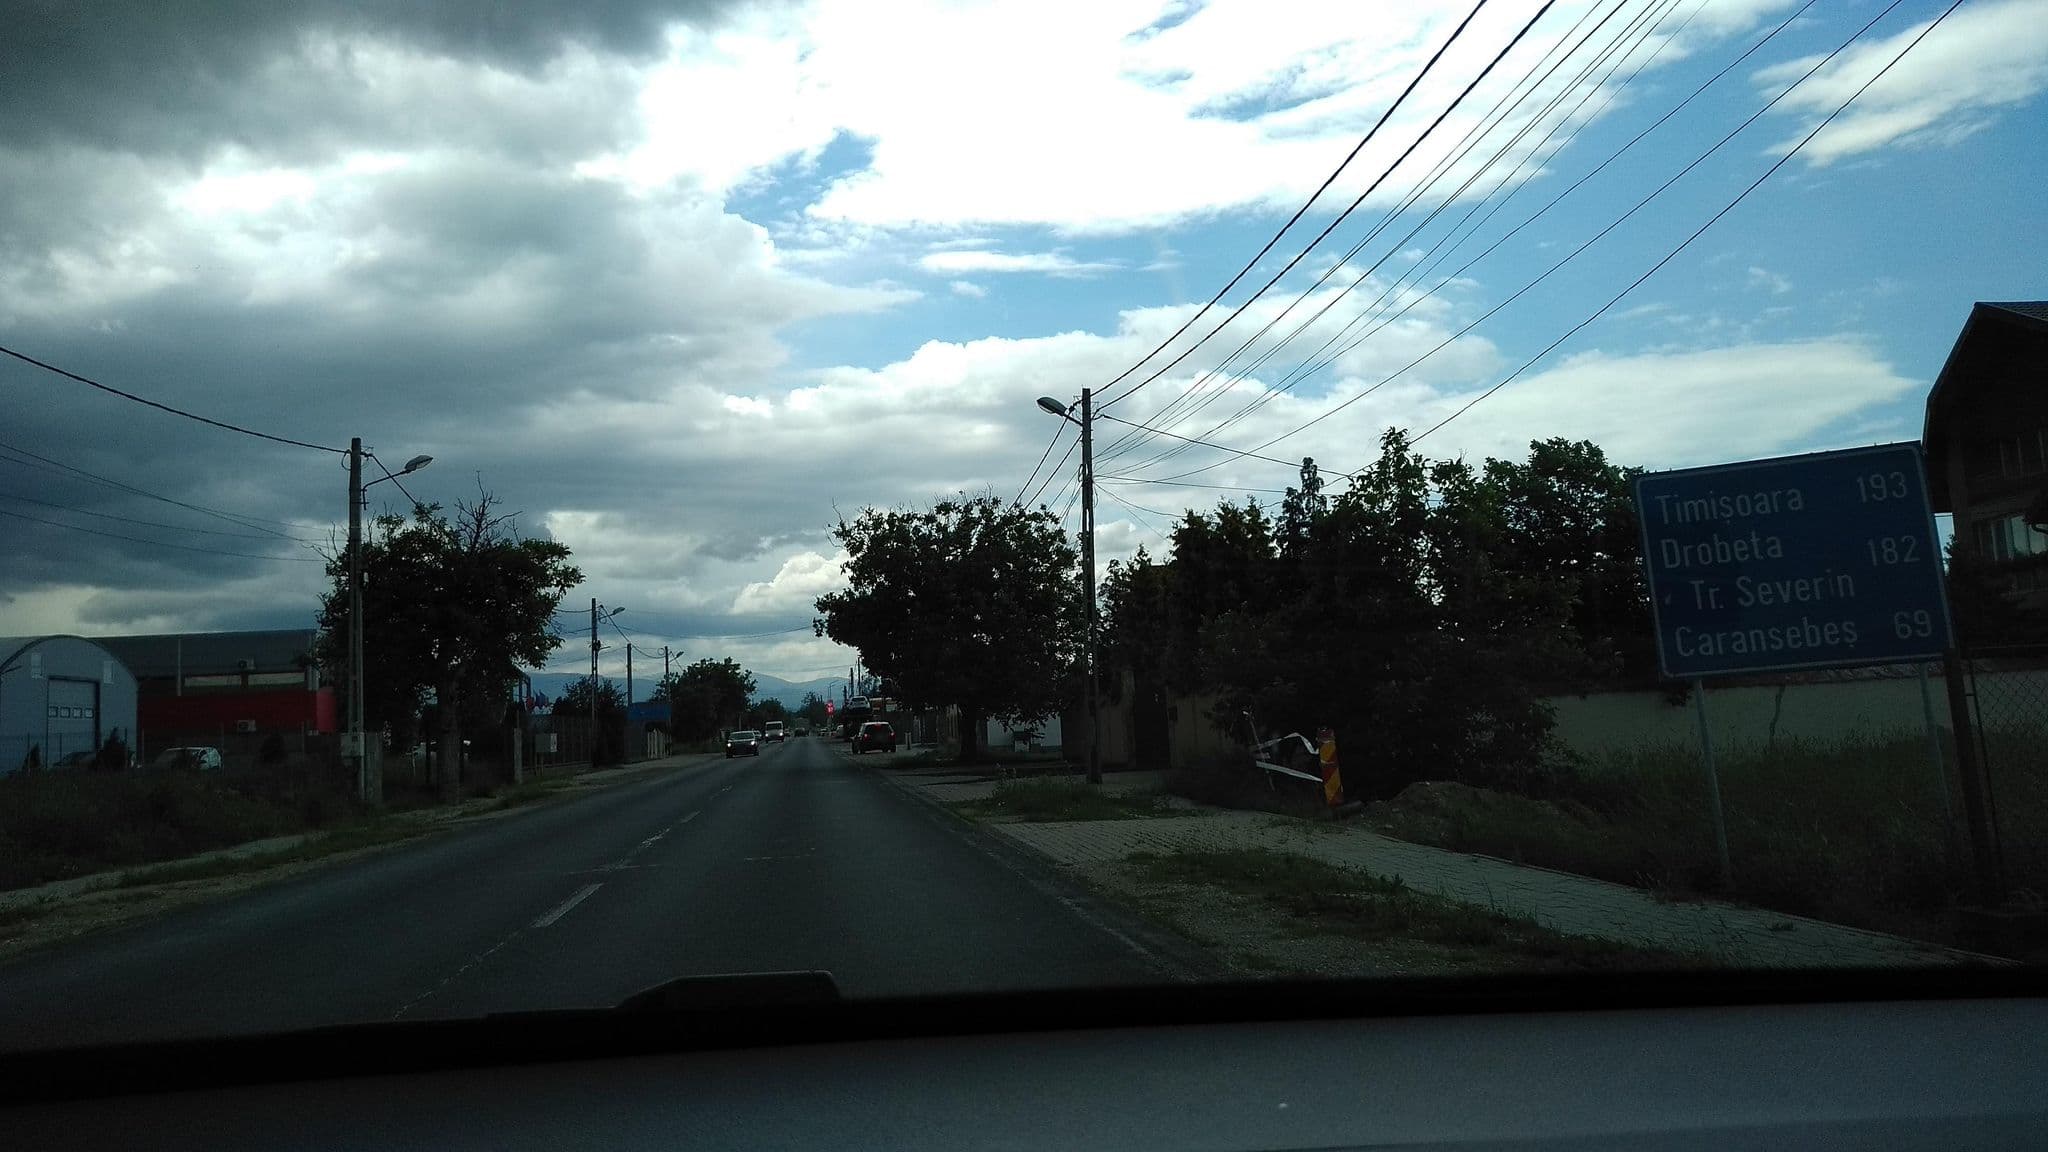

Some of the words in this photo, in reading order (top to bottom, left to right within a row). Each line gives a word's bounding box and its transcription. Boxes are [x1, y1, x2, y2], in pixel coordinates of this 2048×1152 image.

[1656, 488, 1804, 525] Timișoara
[1857, 471, 1907, 503] 193
[1660, 531, 1783, 569] Drobeta
[1867, 536, 1920, 566] 182
[1691, 579, 1724, 610] Tr.
[1735, 569, 1855, 607] Severin
[1675, 616, 1858, 657] Caransebeș
[1894, 609, 1932, 639] 69
